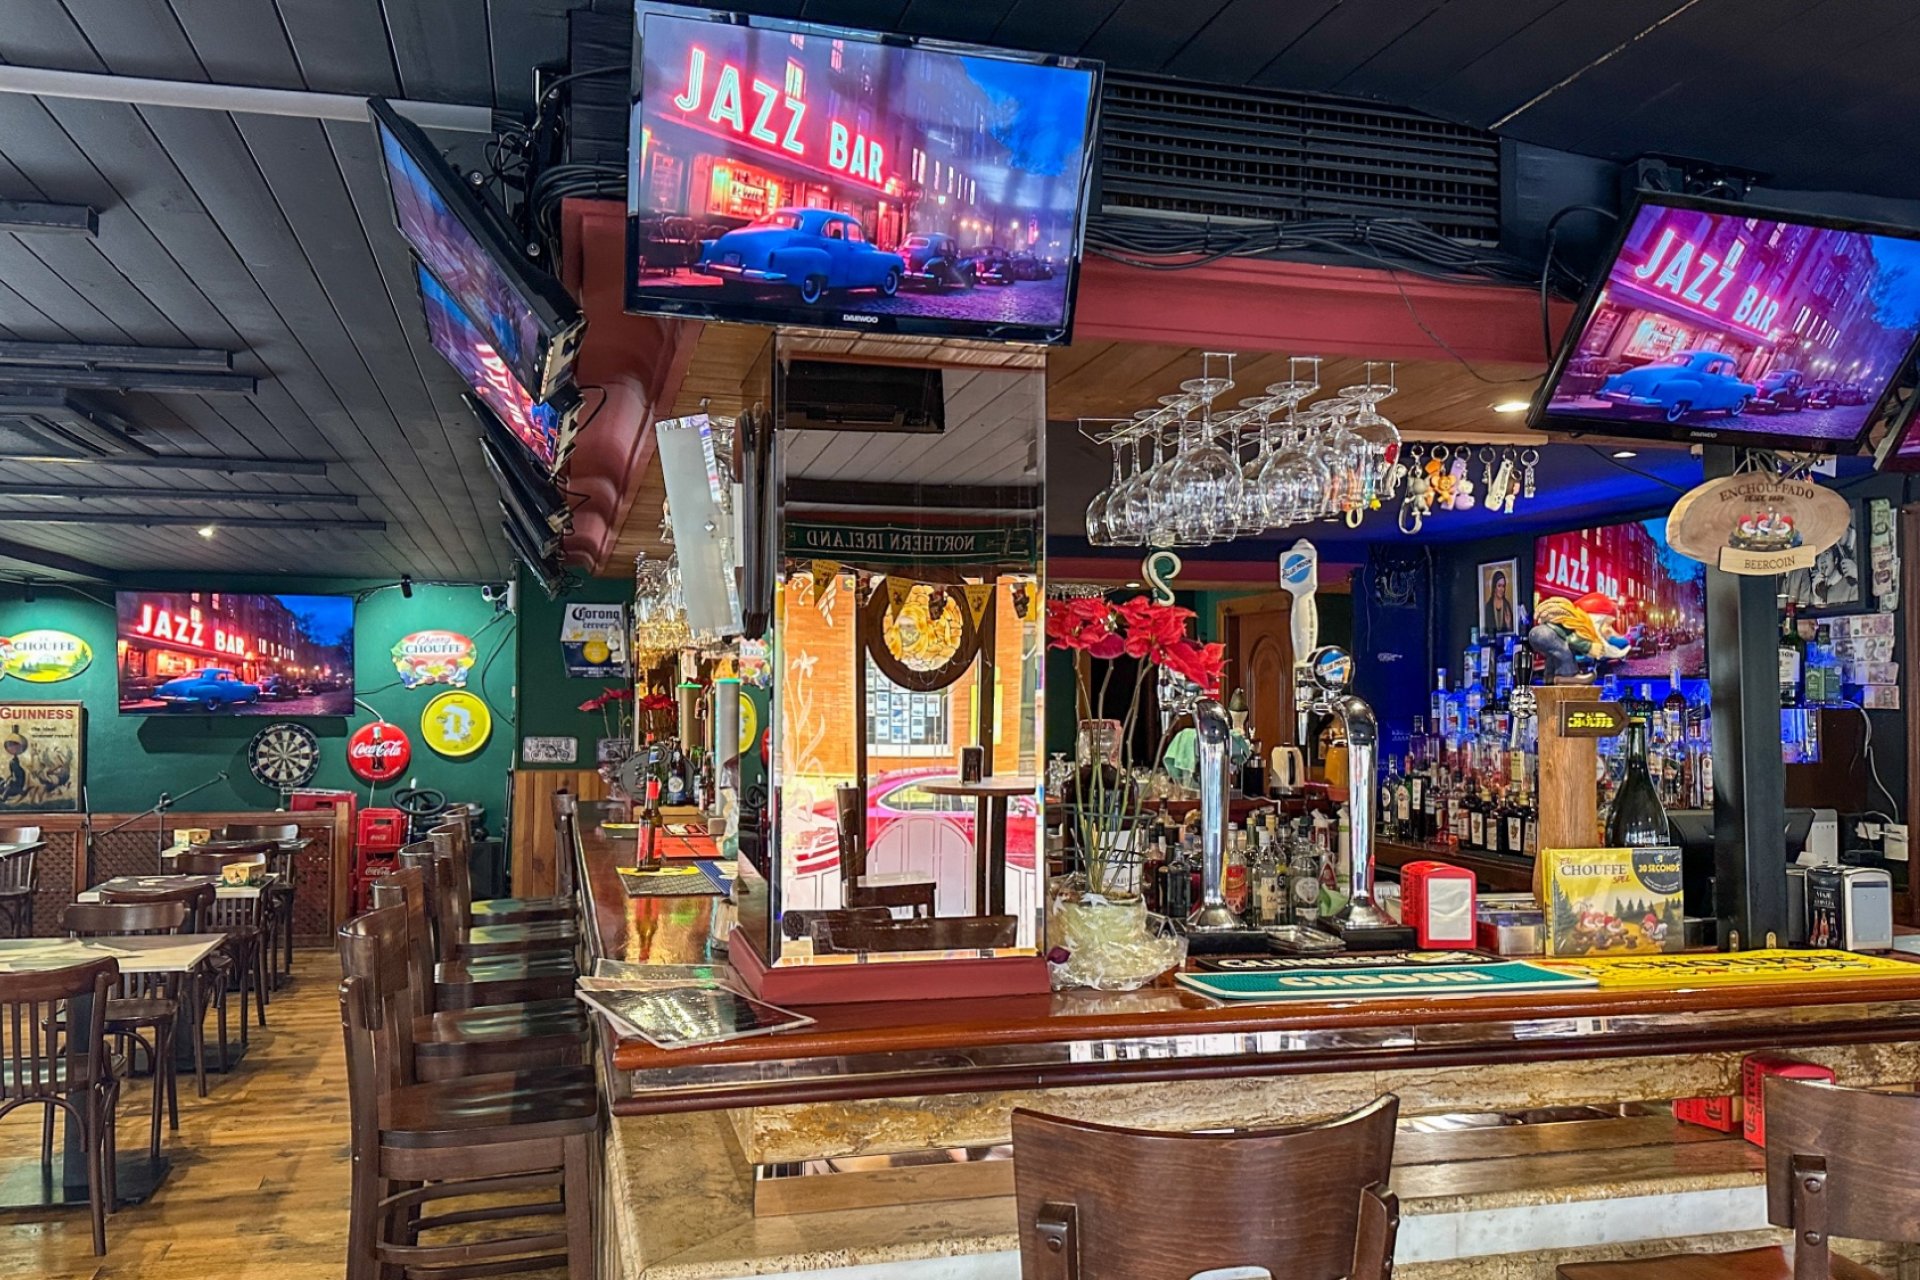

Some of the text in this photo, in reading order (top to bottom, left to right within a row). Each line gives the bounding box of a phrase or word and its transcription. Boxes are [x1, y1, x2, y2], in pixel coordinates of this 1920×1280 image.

[674, 48, 884, 183] JAZZ BAR
[1635, 227, 1780, 332] JAZZ BAR
[843, 314, 879, 323] DAEWOO
[1719, 482, 1815, 503] ENCHOUFFADO
[1744, 555, 1795, 570] BEERCOIN
[1545, 548, 1618, 601] JAZZ BAR
[572, 607, 620, 621] Corona
[136, 604, 245, 656] JAZZ BAR
[13, 642, 75, 651] CHOUFFE
[0, 707, 74, 720] GUINNESS
[352, 740, 404, 758] Coca-Cola
[1561, 865, 1627, 876] CHOUFFE
[1648, 863, 1681, 873] SECONDS
[1278, 970, 1494, 987] CHOOSE!
